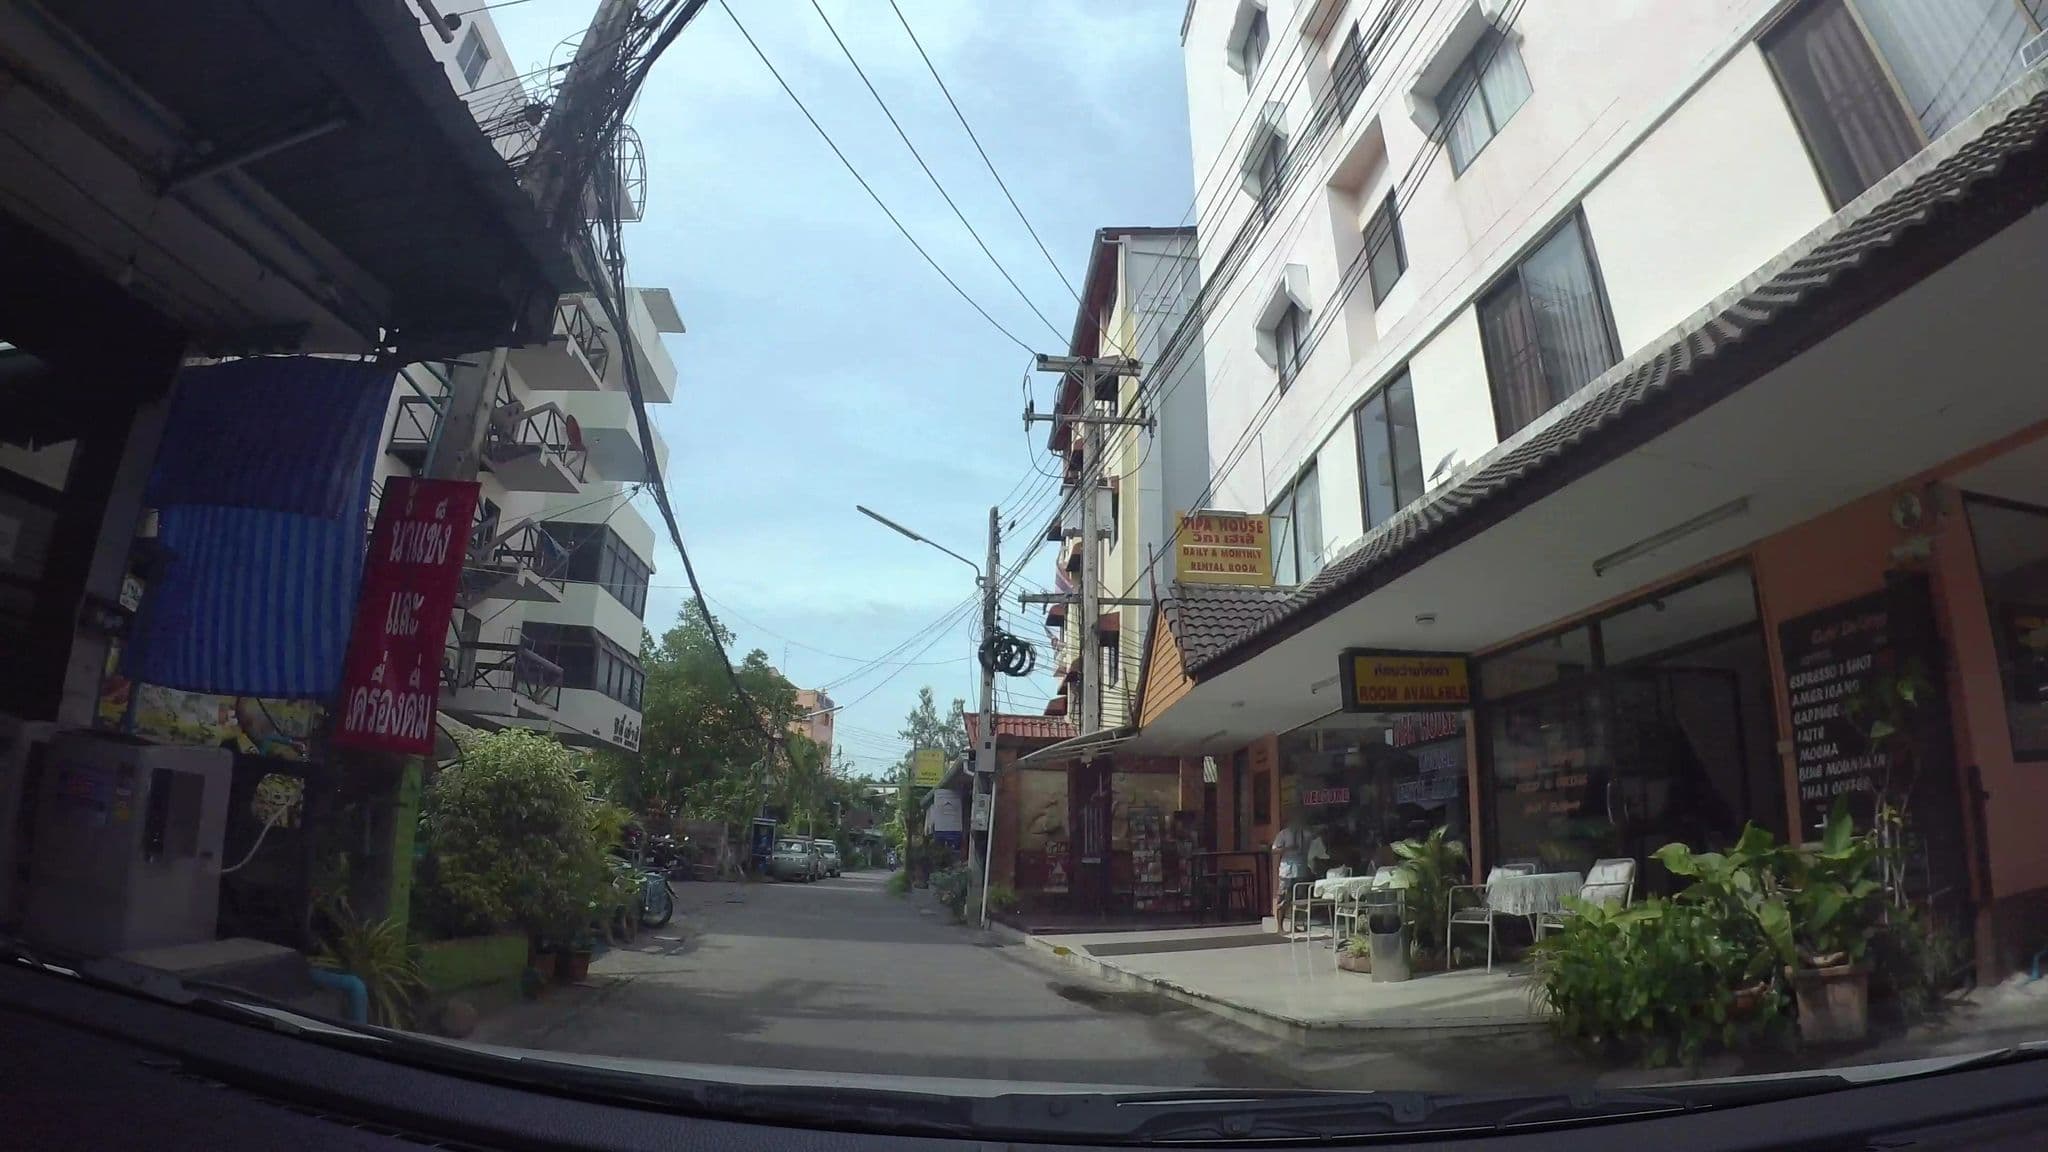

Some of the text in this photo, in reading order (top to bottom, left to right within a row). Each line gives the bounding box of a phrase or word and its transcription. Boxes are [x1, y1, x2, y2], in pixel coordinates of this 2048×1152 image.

[1220, 518, 1264, 534] HOUSE
[1183, 547, 1208, 558] DAILY
[1220, 548, 1262, 560] MONTHLY
[1190, 561, 1258, 574] RENTAL ROOM
[385, 591, 425, 636] และ
[1789, 663, 1838, 690] ESPRESSO
[1846, 653, 1873, 675] SHOT
[345, 650, 432, 740] เครื่องดื่ม
[1359, 685, 1469, 701] ROOM AVAILABLE
[1792, 679, 1860, 707] AMERICANO
[1800, 742, 1840, 762] MOCHA
[1303, 788, 1350, 805] WELCOME
[1803, 781, 1830, 800] THAI
